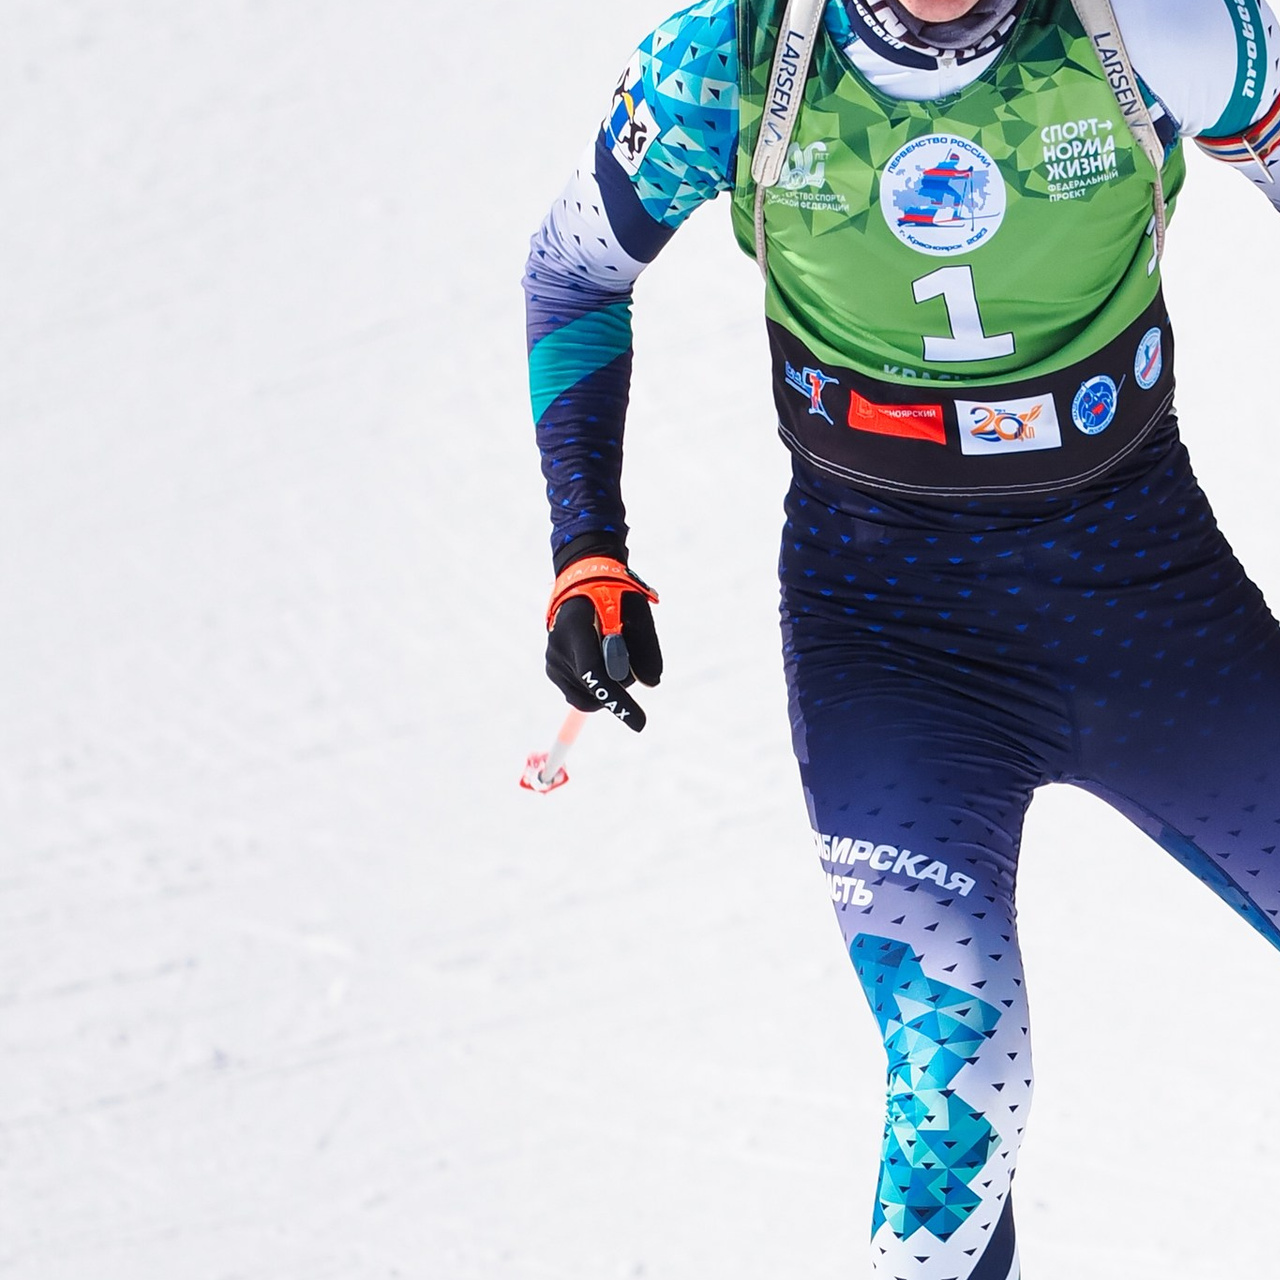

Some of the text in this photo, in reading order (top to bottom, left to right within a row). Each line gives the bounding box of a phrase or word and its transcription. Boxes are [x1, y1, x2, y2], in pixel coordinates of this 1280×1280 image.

[769, 29, 805, 121] LARSEN
[1093, 31, 1141, 117] LARSEN
[1040, 118, 1098, 144] СПОРТ
[887, 136, 992, 174] ПЕРВЕНСТВО РОССИИ
[1043, 134, 1116, 163] НОРМА
[1046, 151, 1117, 182] ЖИЗНИ
[1046, 169, 1119, 193] ФЕДЕРАЛЬНЫЙ
[815, 194, 847, 203] СПОРТА
[1048, 188, 1087, 203] ПРОЕКТ
[911, 265, 1016, 363] 1
[581, 671, 631, 721] MOAX
